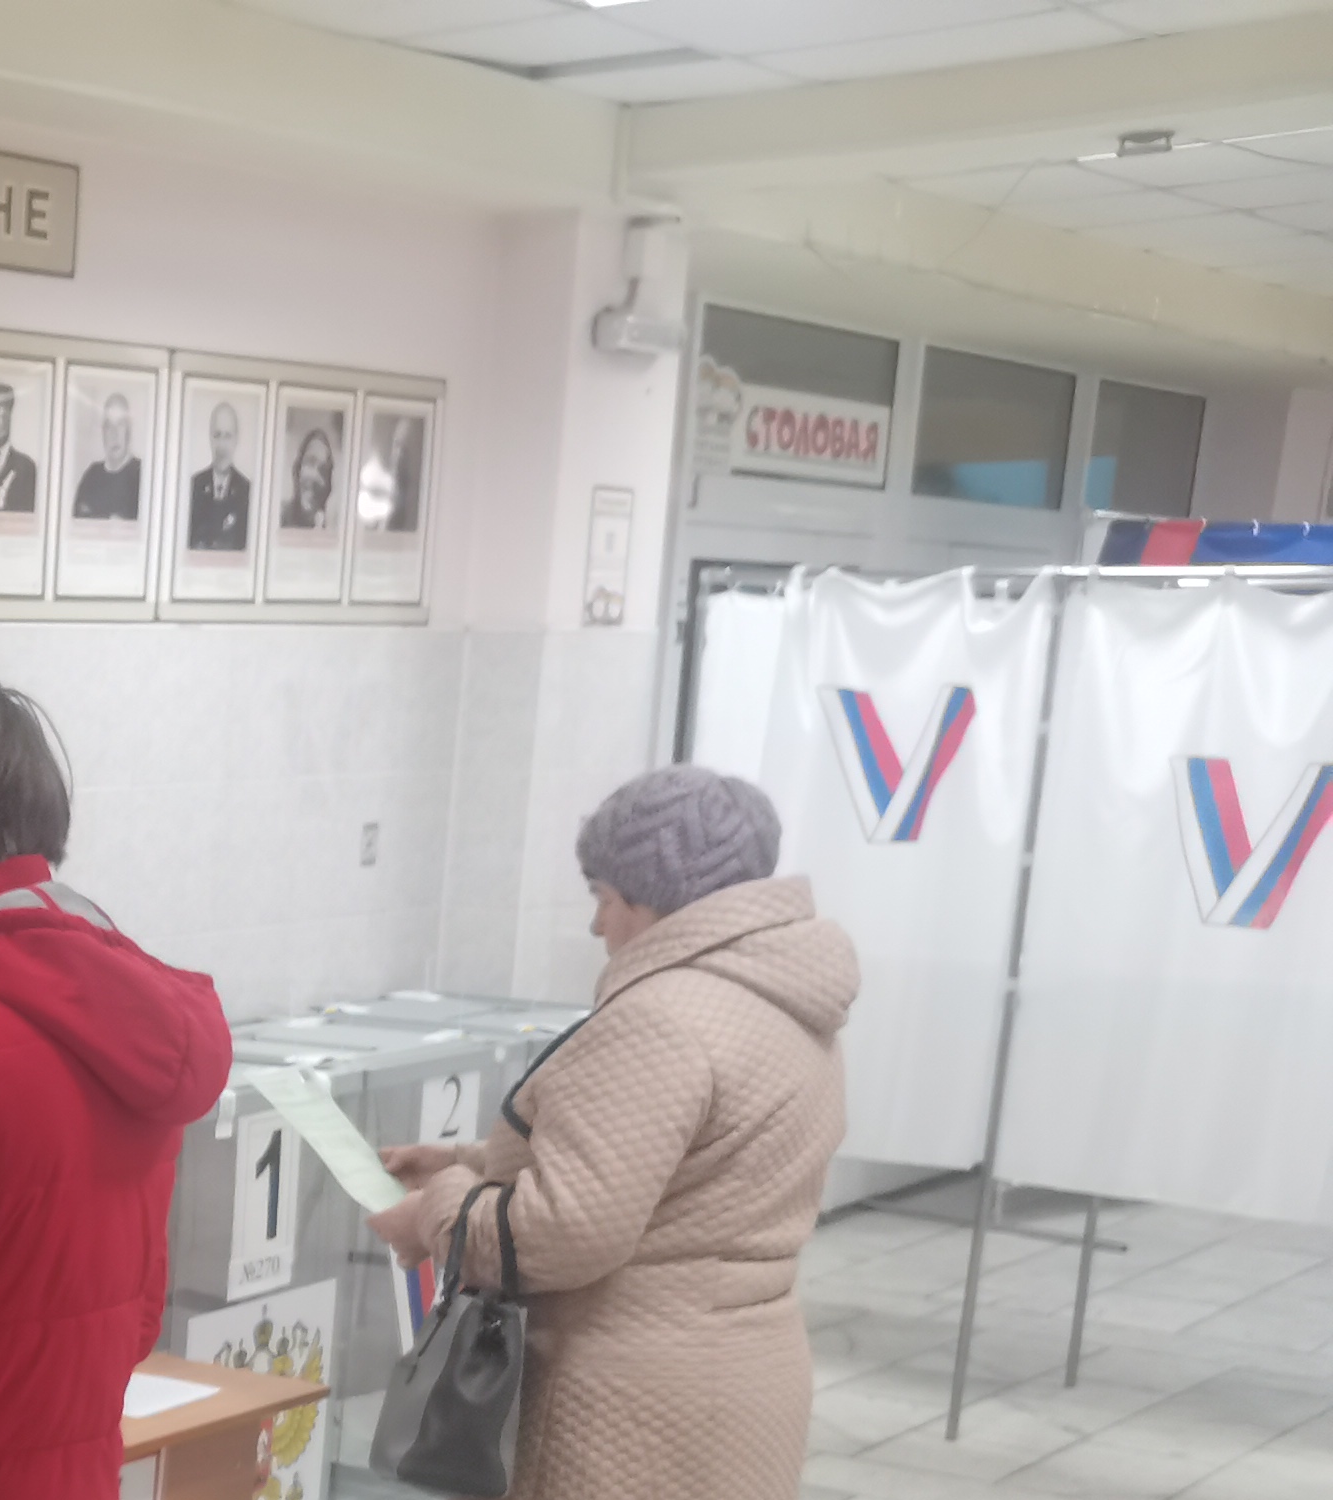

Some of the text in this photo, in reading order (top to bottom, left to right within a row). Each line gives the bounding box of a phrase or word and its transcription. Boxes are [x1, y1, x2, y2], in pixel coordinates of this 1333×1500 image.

[745, 404, 879, 463] СТОЛОВАЯ
[438, 1073, 462, 1138] 2
[255, 1128, 282, 1240] 1
